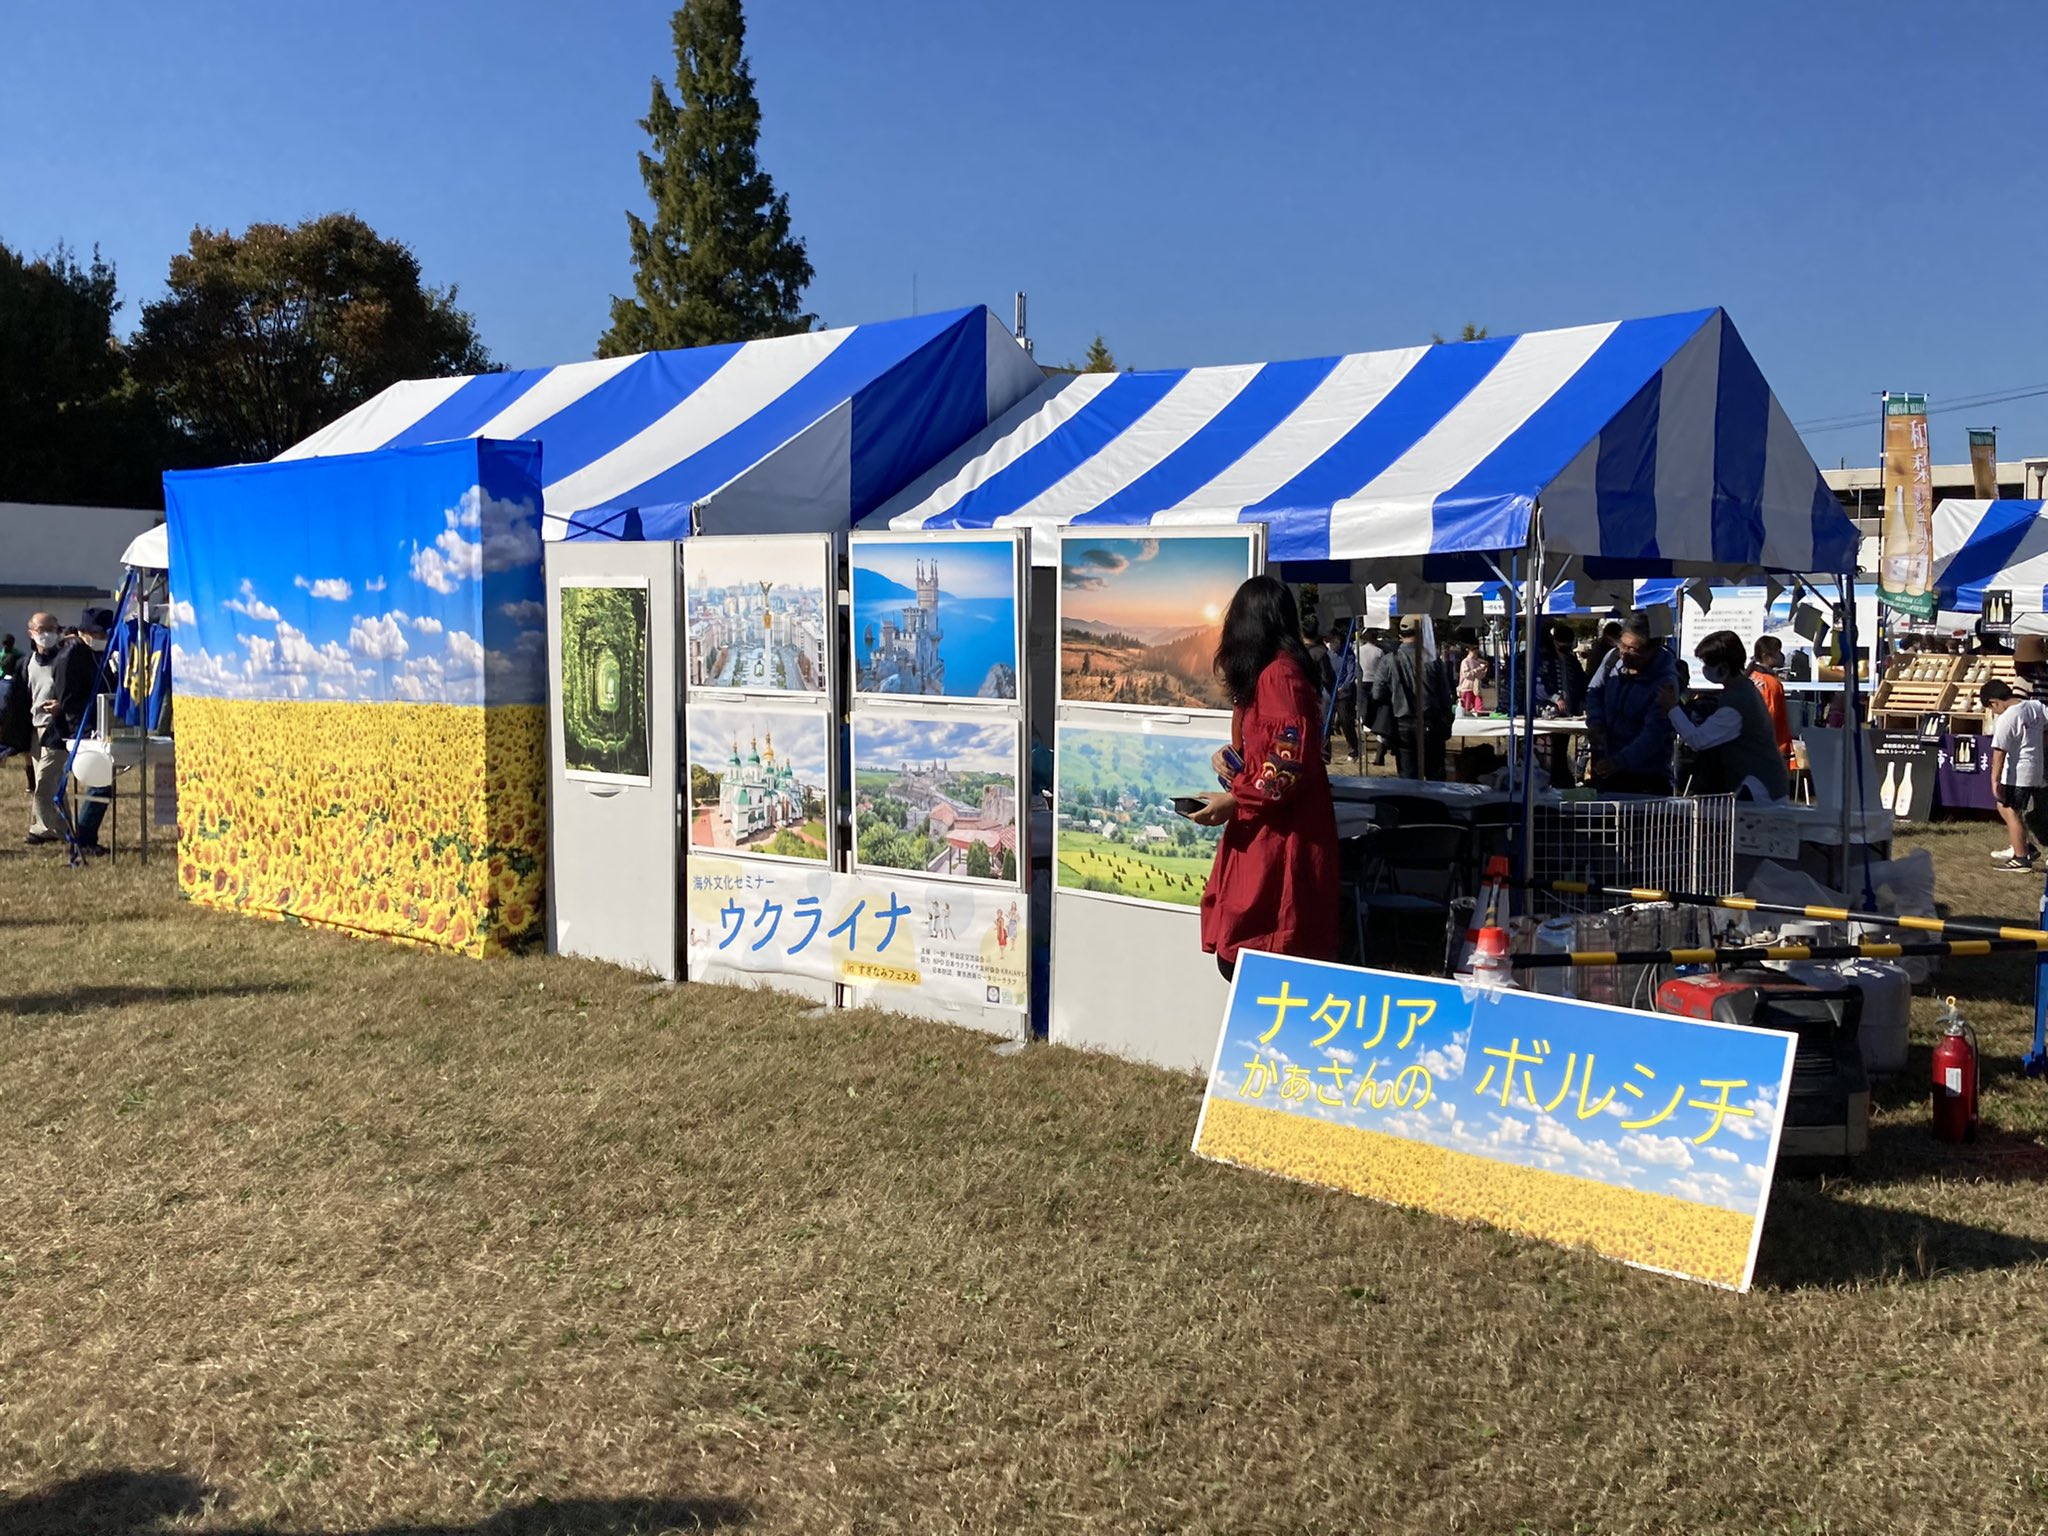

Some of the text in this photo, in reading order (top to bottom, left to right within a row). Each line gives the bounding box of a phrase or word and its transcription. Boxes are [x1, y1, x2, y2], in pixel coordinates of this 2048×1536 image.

[693, 875, 775, 891] 海外文化セミナー
[718, 891, 912, 955] ウクライナ
[858, 964, 917, 983] すぎなみフェスタ
[1254, 980, 1438, 1051] ナタリア
[1238, 1053, 1433, 1112] かぁさんの
[1473, 1036, 1757, 1147] ボルシチ
